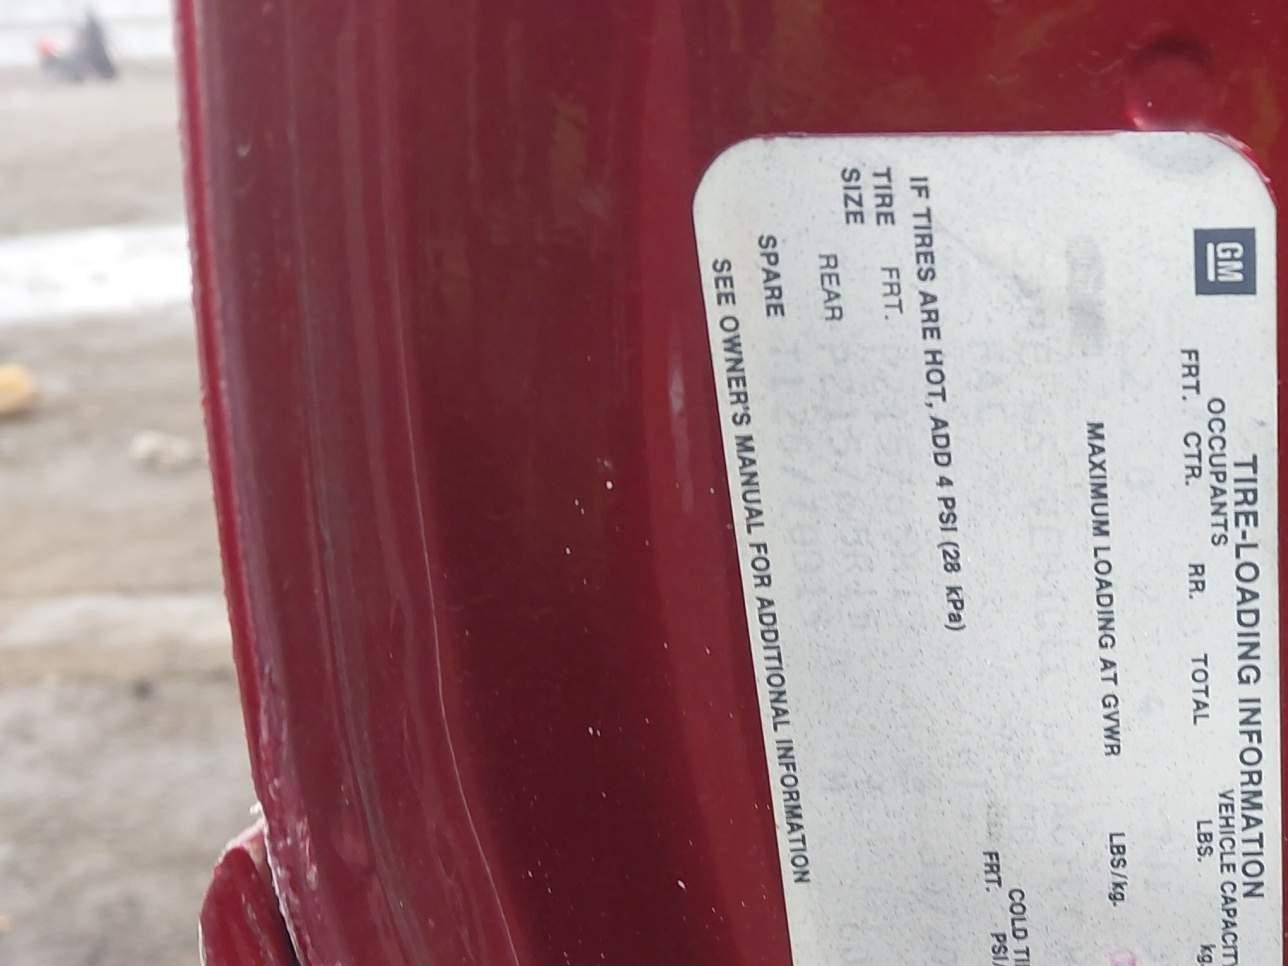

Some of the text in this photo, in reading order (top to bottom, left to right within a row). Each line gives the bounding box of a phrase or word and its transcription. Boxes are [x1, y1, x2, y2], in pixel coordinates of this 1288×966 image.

[841, 168, 864, 224] SIZE
[872, 167, 895, 226] TIRE
[712, 259, 736, 306] SEE
[758, 235, 785, 317] SPARE
[819, 254, 843, 321] REAR
[881, 267, 903, 320] FRT.
[1216, 241, 1243, 282] GM
[719, 316, 751, 426] OWNER'S
[910, 177, 966, 631] IF TIRES ARE HOT, ADD 4 PSI (28 kPa)
[1181, 349, 1200, 400] FRT.
[735, 435, 764, 534] MANUAL
[1184, 432, 1202, 485] CTR.
[1207, 398, 1228, 546] OCCUPANTS
[750, 542, 770, 588] FOR
[1087, 423, 1121, 756] MAXIMUM LOADING AT GVWR
[1189, 564, 1205, 599] RR.
[757, 598, 790, 731] ADDITIONAL
[1192, 653, 1209, 725] TOTAL
[1234, 454, 1264, 898] TIRE-LOADING INFORMATION
[776, 740, 810, 884] INFORMATION
[1197, 820, 1213, 862] LBS.
[1219, 789, 1236, 874] VEHICLE
[983, 851, 1002, 892] FRT.
[1108, 833, 1127, 906] LBS/kg.
[1008, 889, 1028, 940] COLD
